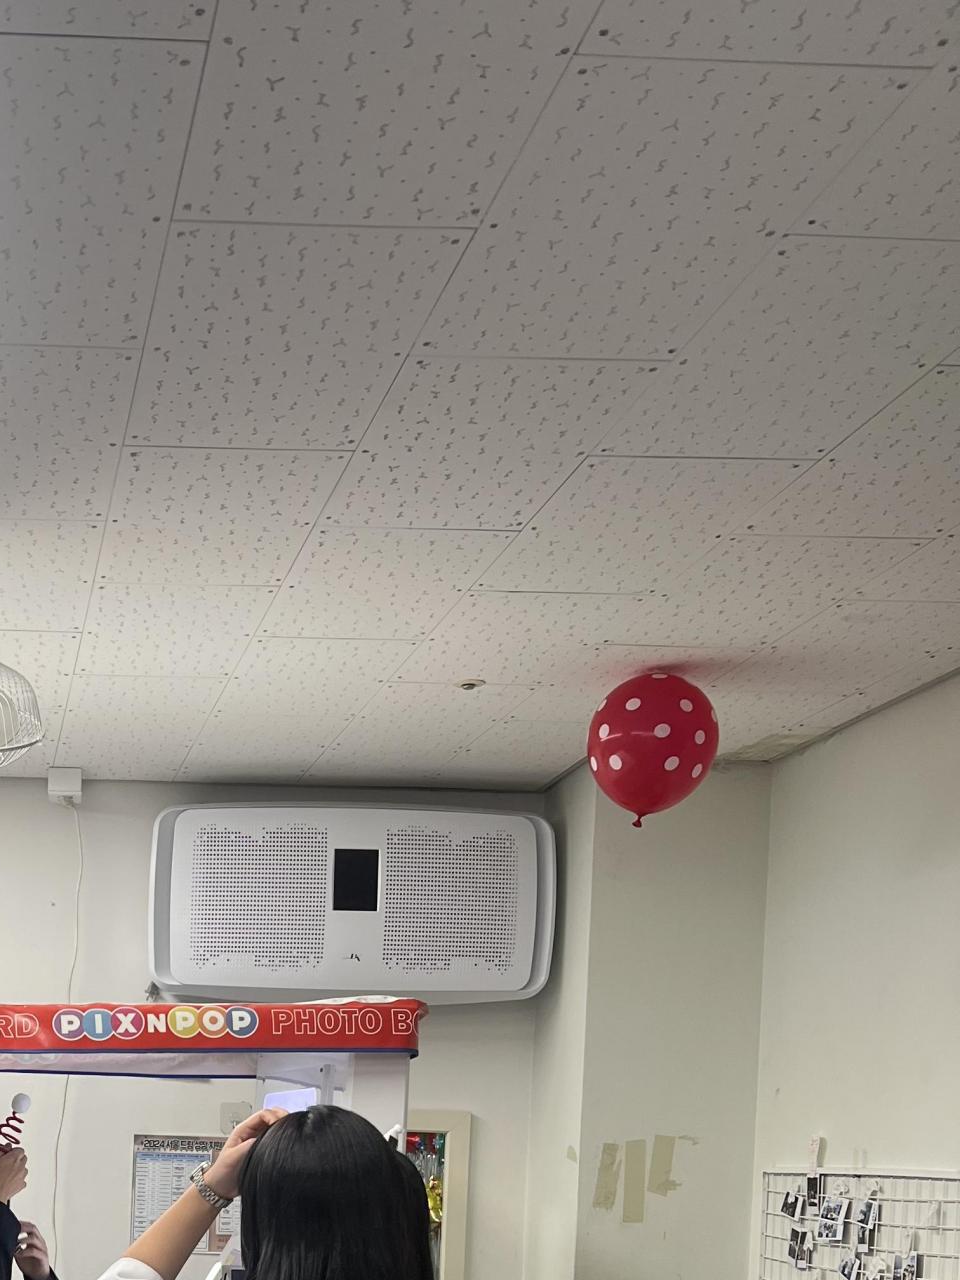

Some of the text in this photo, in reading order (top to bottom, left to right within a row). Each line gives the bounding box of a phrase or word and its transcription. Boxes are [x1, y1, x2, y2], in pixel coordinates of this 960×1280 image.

[55, 1008, 256, 1039] PIXNPOP
[271, 1008, 383, 1036] PHOTO
[143, 1139, 165, 1148] 2024
